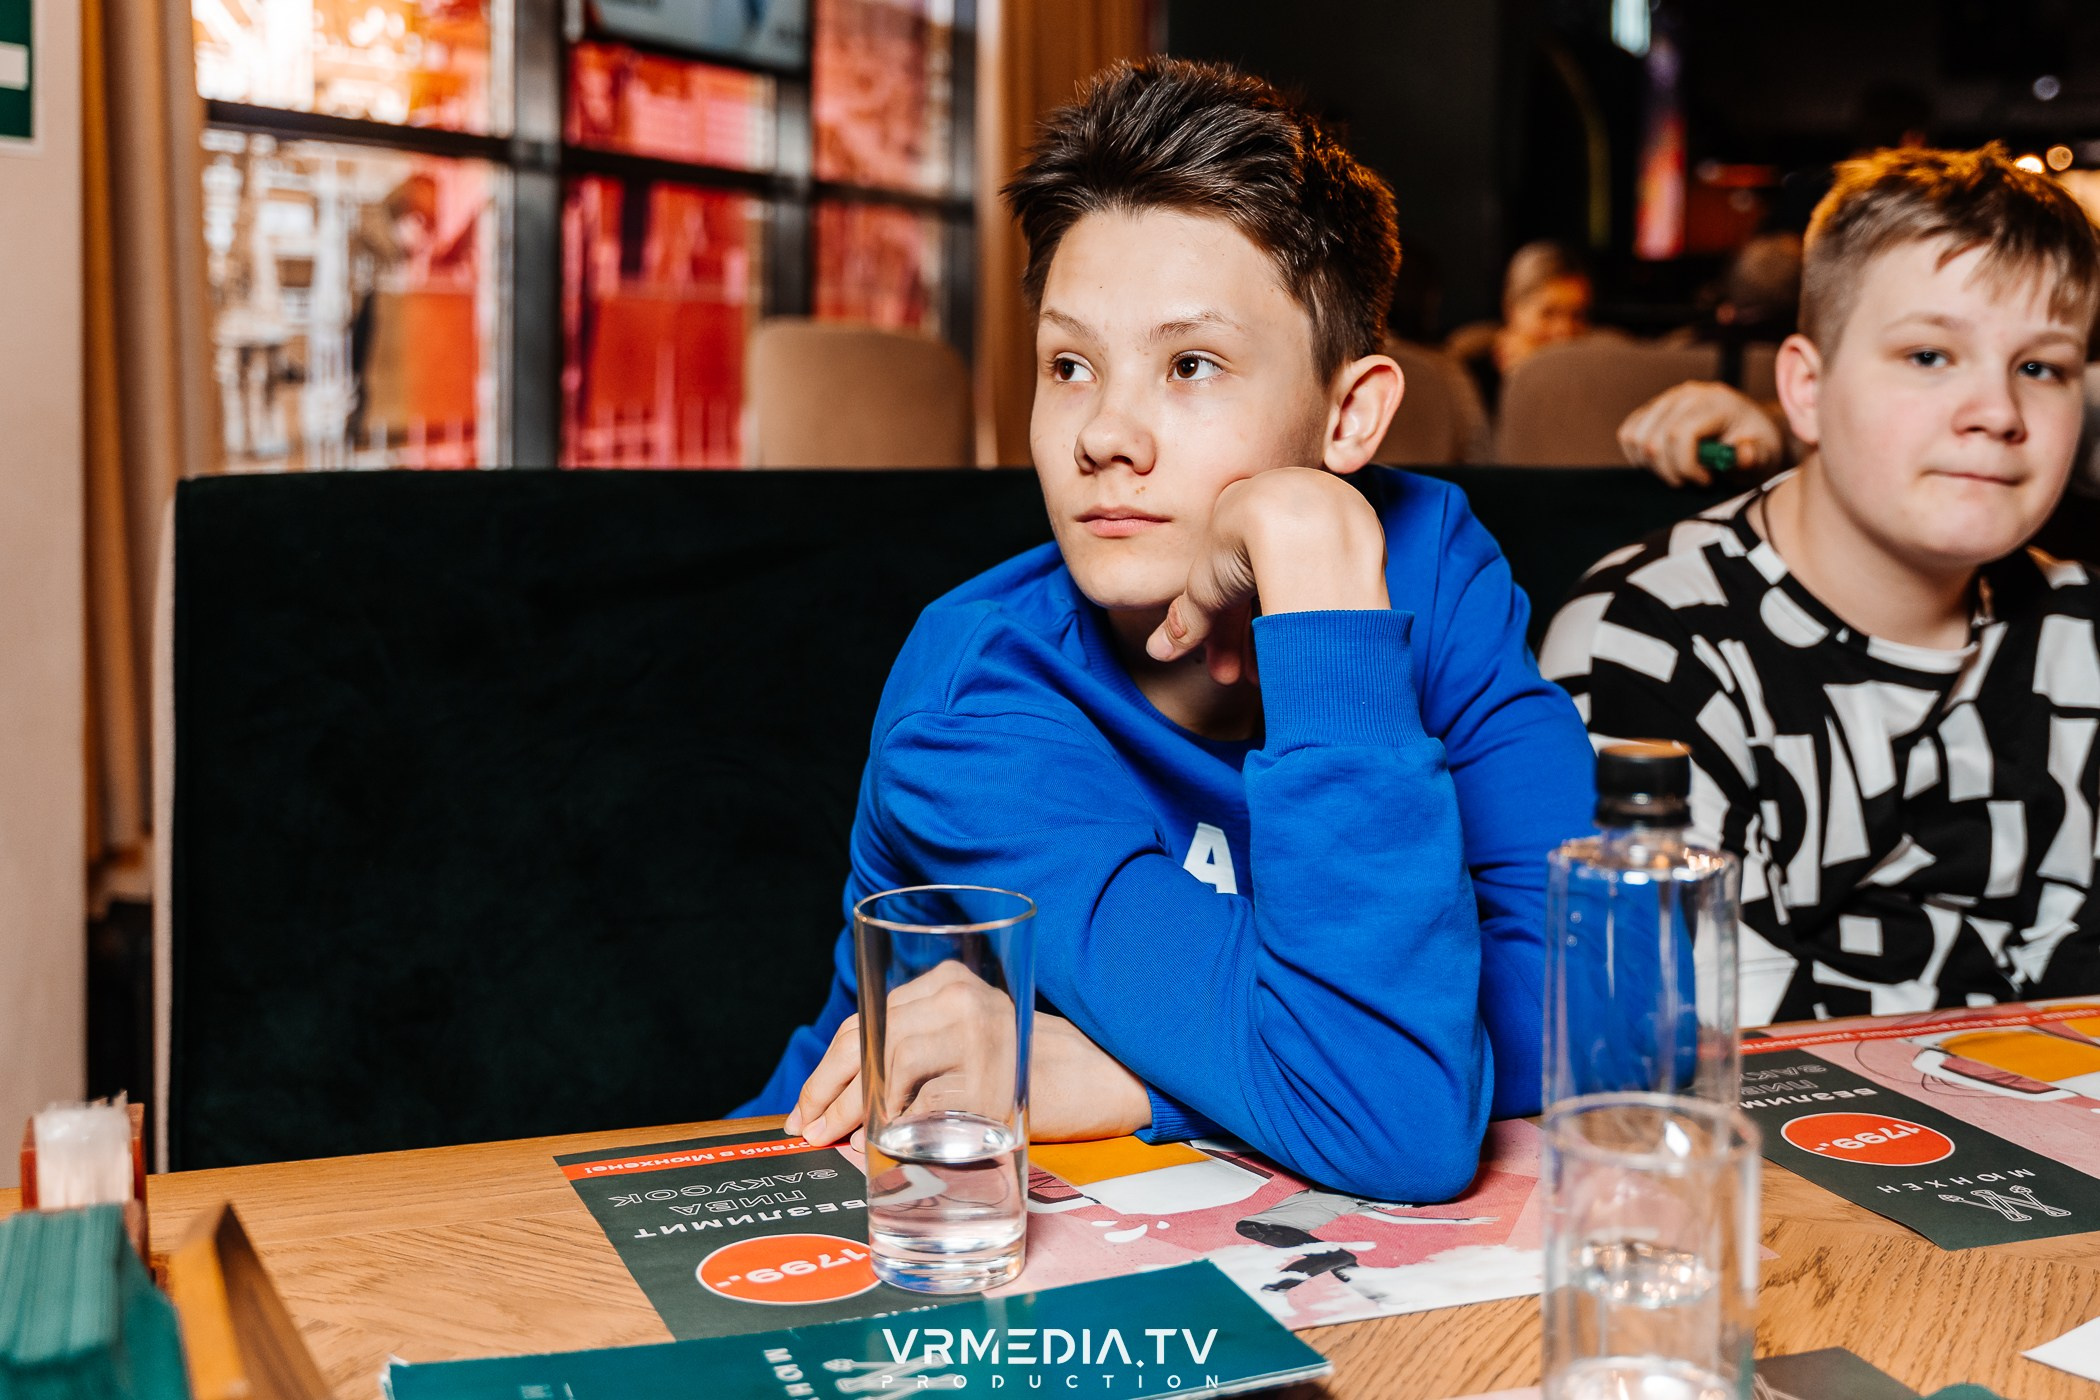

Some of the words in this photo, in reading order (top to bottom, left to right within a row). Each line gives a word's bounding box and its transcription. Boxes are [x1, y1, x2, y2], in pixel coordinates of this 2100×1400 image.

[1738, 1087, 1879, 1110] БЕЗЛИМ
[607, 1168, 839, 1208] ЗАКУСОК
[1876, 1168, 2036, 1195] МЮНХЕН
[668, 1189, 807, 1216] ПИВА
[633, 1198, 869, 1239] БЕЗЛИМИТ
